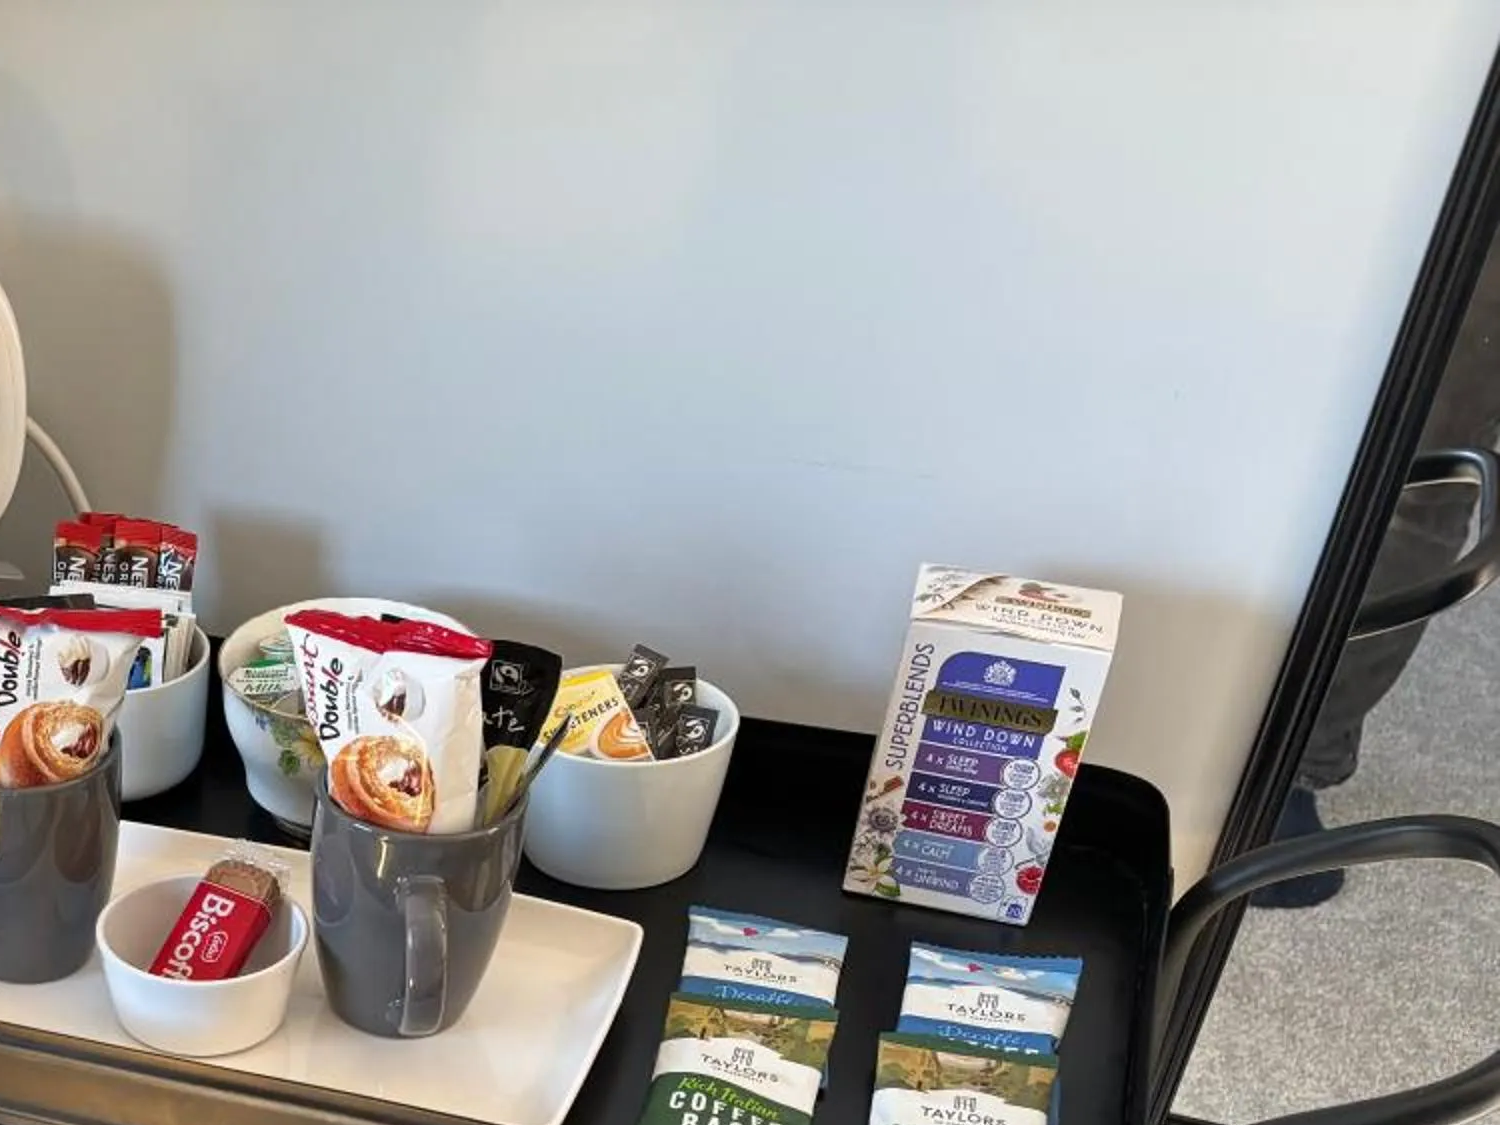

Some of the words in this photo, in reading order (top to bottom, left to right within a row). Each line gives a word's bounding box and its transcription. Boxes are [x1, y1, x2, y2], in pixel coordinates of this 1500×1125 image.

[319, 657, 345, 741] Double
[885, 643, 935, 770] SUPERBLENDS
[939, 694, 1042, 728] TWININGS
[543, 696, 620, 741] STENERS
[931, 718, 977, 738] WIND
[983, 729, 1035, 749] DOWN
[946, 752, 980, 767] SLEEP
[951, 737, 1009, 754] COLLECTION
[938, 782, 971, 798] SLEEP
[724, 963, 798, 984] TAYLORS
[947, 1003, 1028, 1022] TAYLORS
[701, 1053, 779, 1082] TAYLORS
[678, 1076, 718, 1097] Rich
[720, 1087, 779, 1120] Italian
